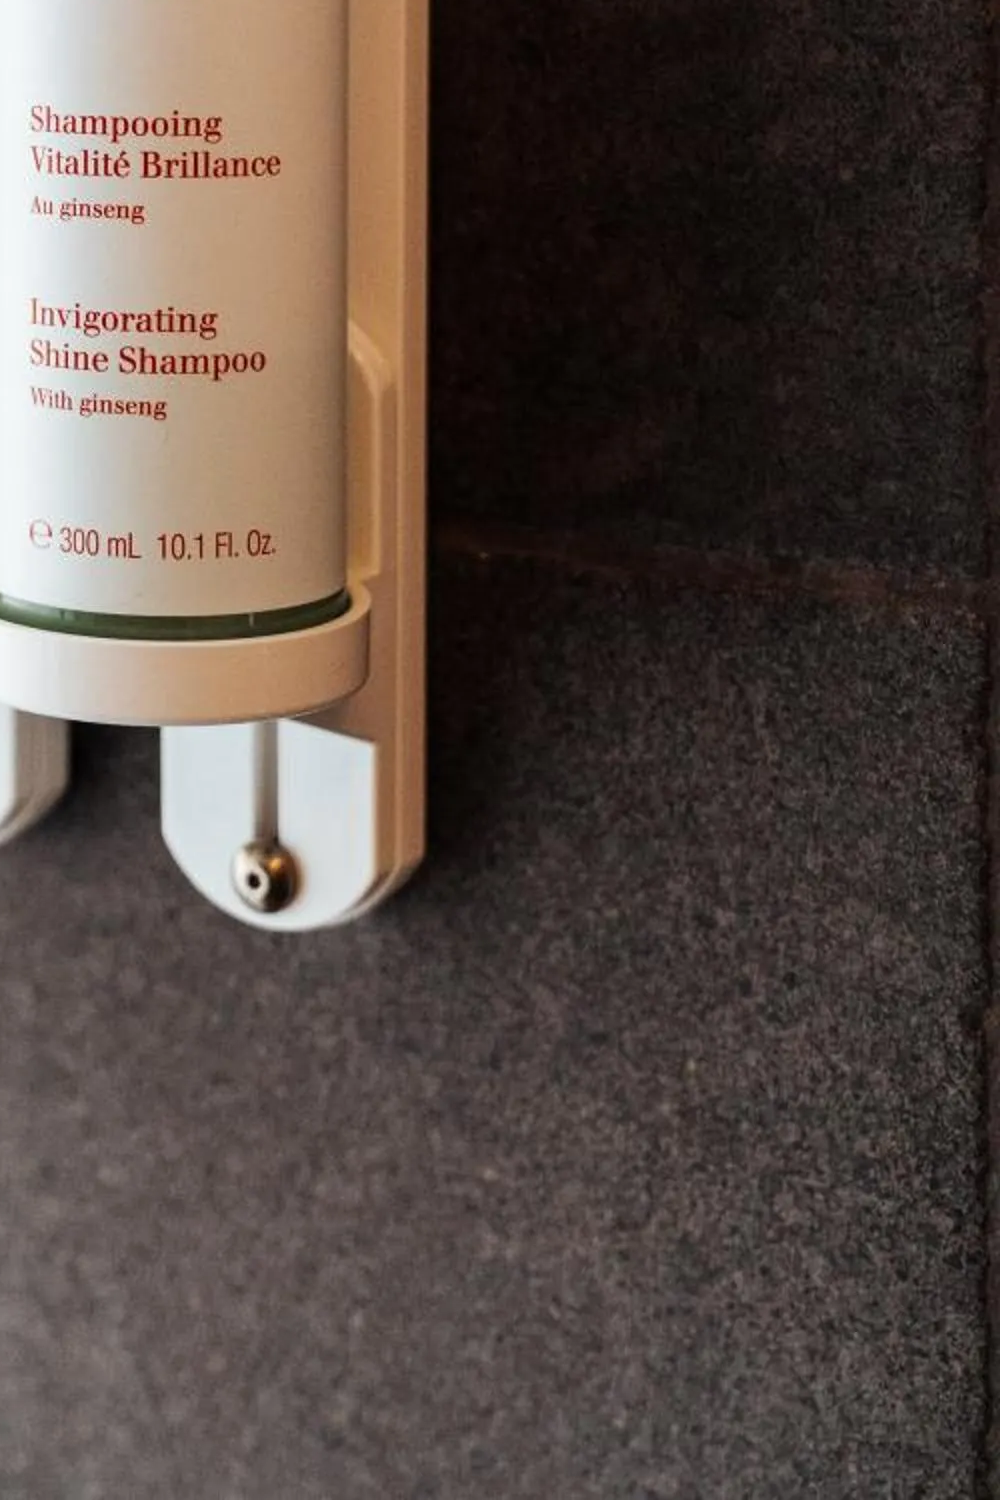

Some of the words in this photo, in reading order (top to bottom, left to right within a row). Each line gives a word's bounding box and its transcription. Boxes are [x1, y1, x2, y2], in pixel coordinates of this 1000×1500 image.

[30, 105, 224, 144] Shampooing
[30, 146, 131, 179] Vitalité
[139, 150, 282, 180] Brillance
[30, 195, 54, 215] Au
[59, 200, 146, 225] ginseng
[29, 298, 219, 340] Invigorating
[29, 338, 109, 373] Shine
[119, 346, 267, 381] Shampoo
[30, 386, 74, 411] With
[78, 393, 168, 421] ginseng
[59, 527, 100, 556] 300
[106, 532, 142, 559] mL
[157, 534, 205, 561] 10.1
[214, 531, 240, 558] Fl.
[246, 529, 277, 556] Oz.
